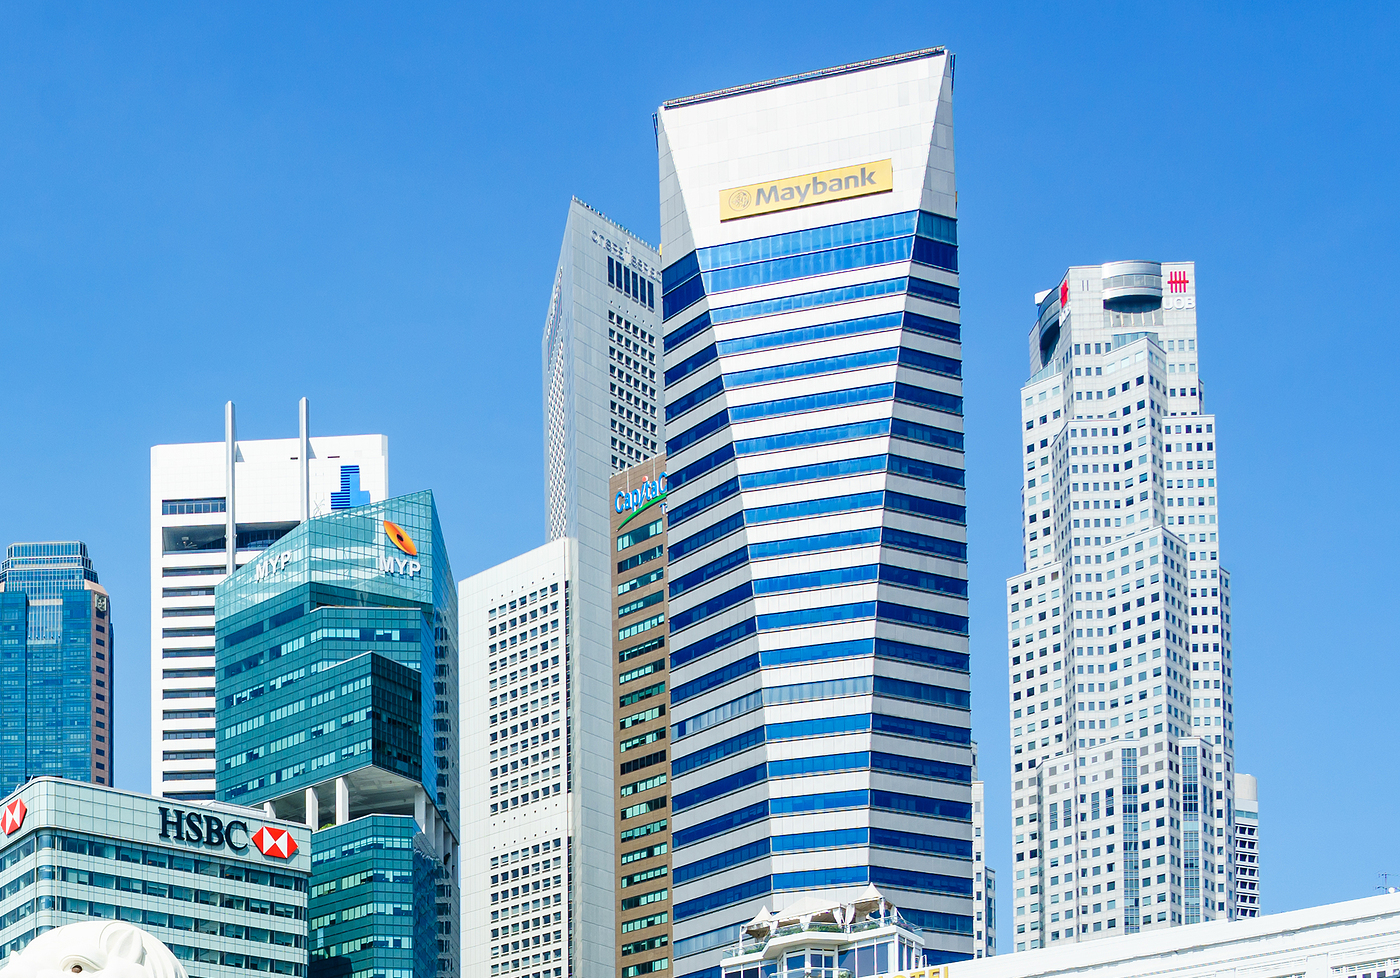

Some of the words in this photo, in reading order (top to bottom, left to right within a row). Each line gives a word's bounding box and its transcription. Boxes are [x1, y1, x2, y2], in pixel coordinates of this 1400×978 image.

[755, 167, 876, 207] Maybank
[1163, 296, 1196, 310] UOB
[255, 551, 292, 581] MYP
[378, 555, 421, 577] MYP
[158, 806, 248, 850] HSBC
